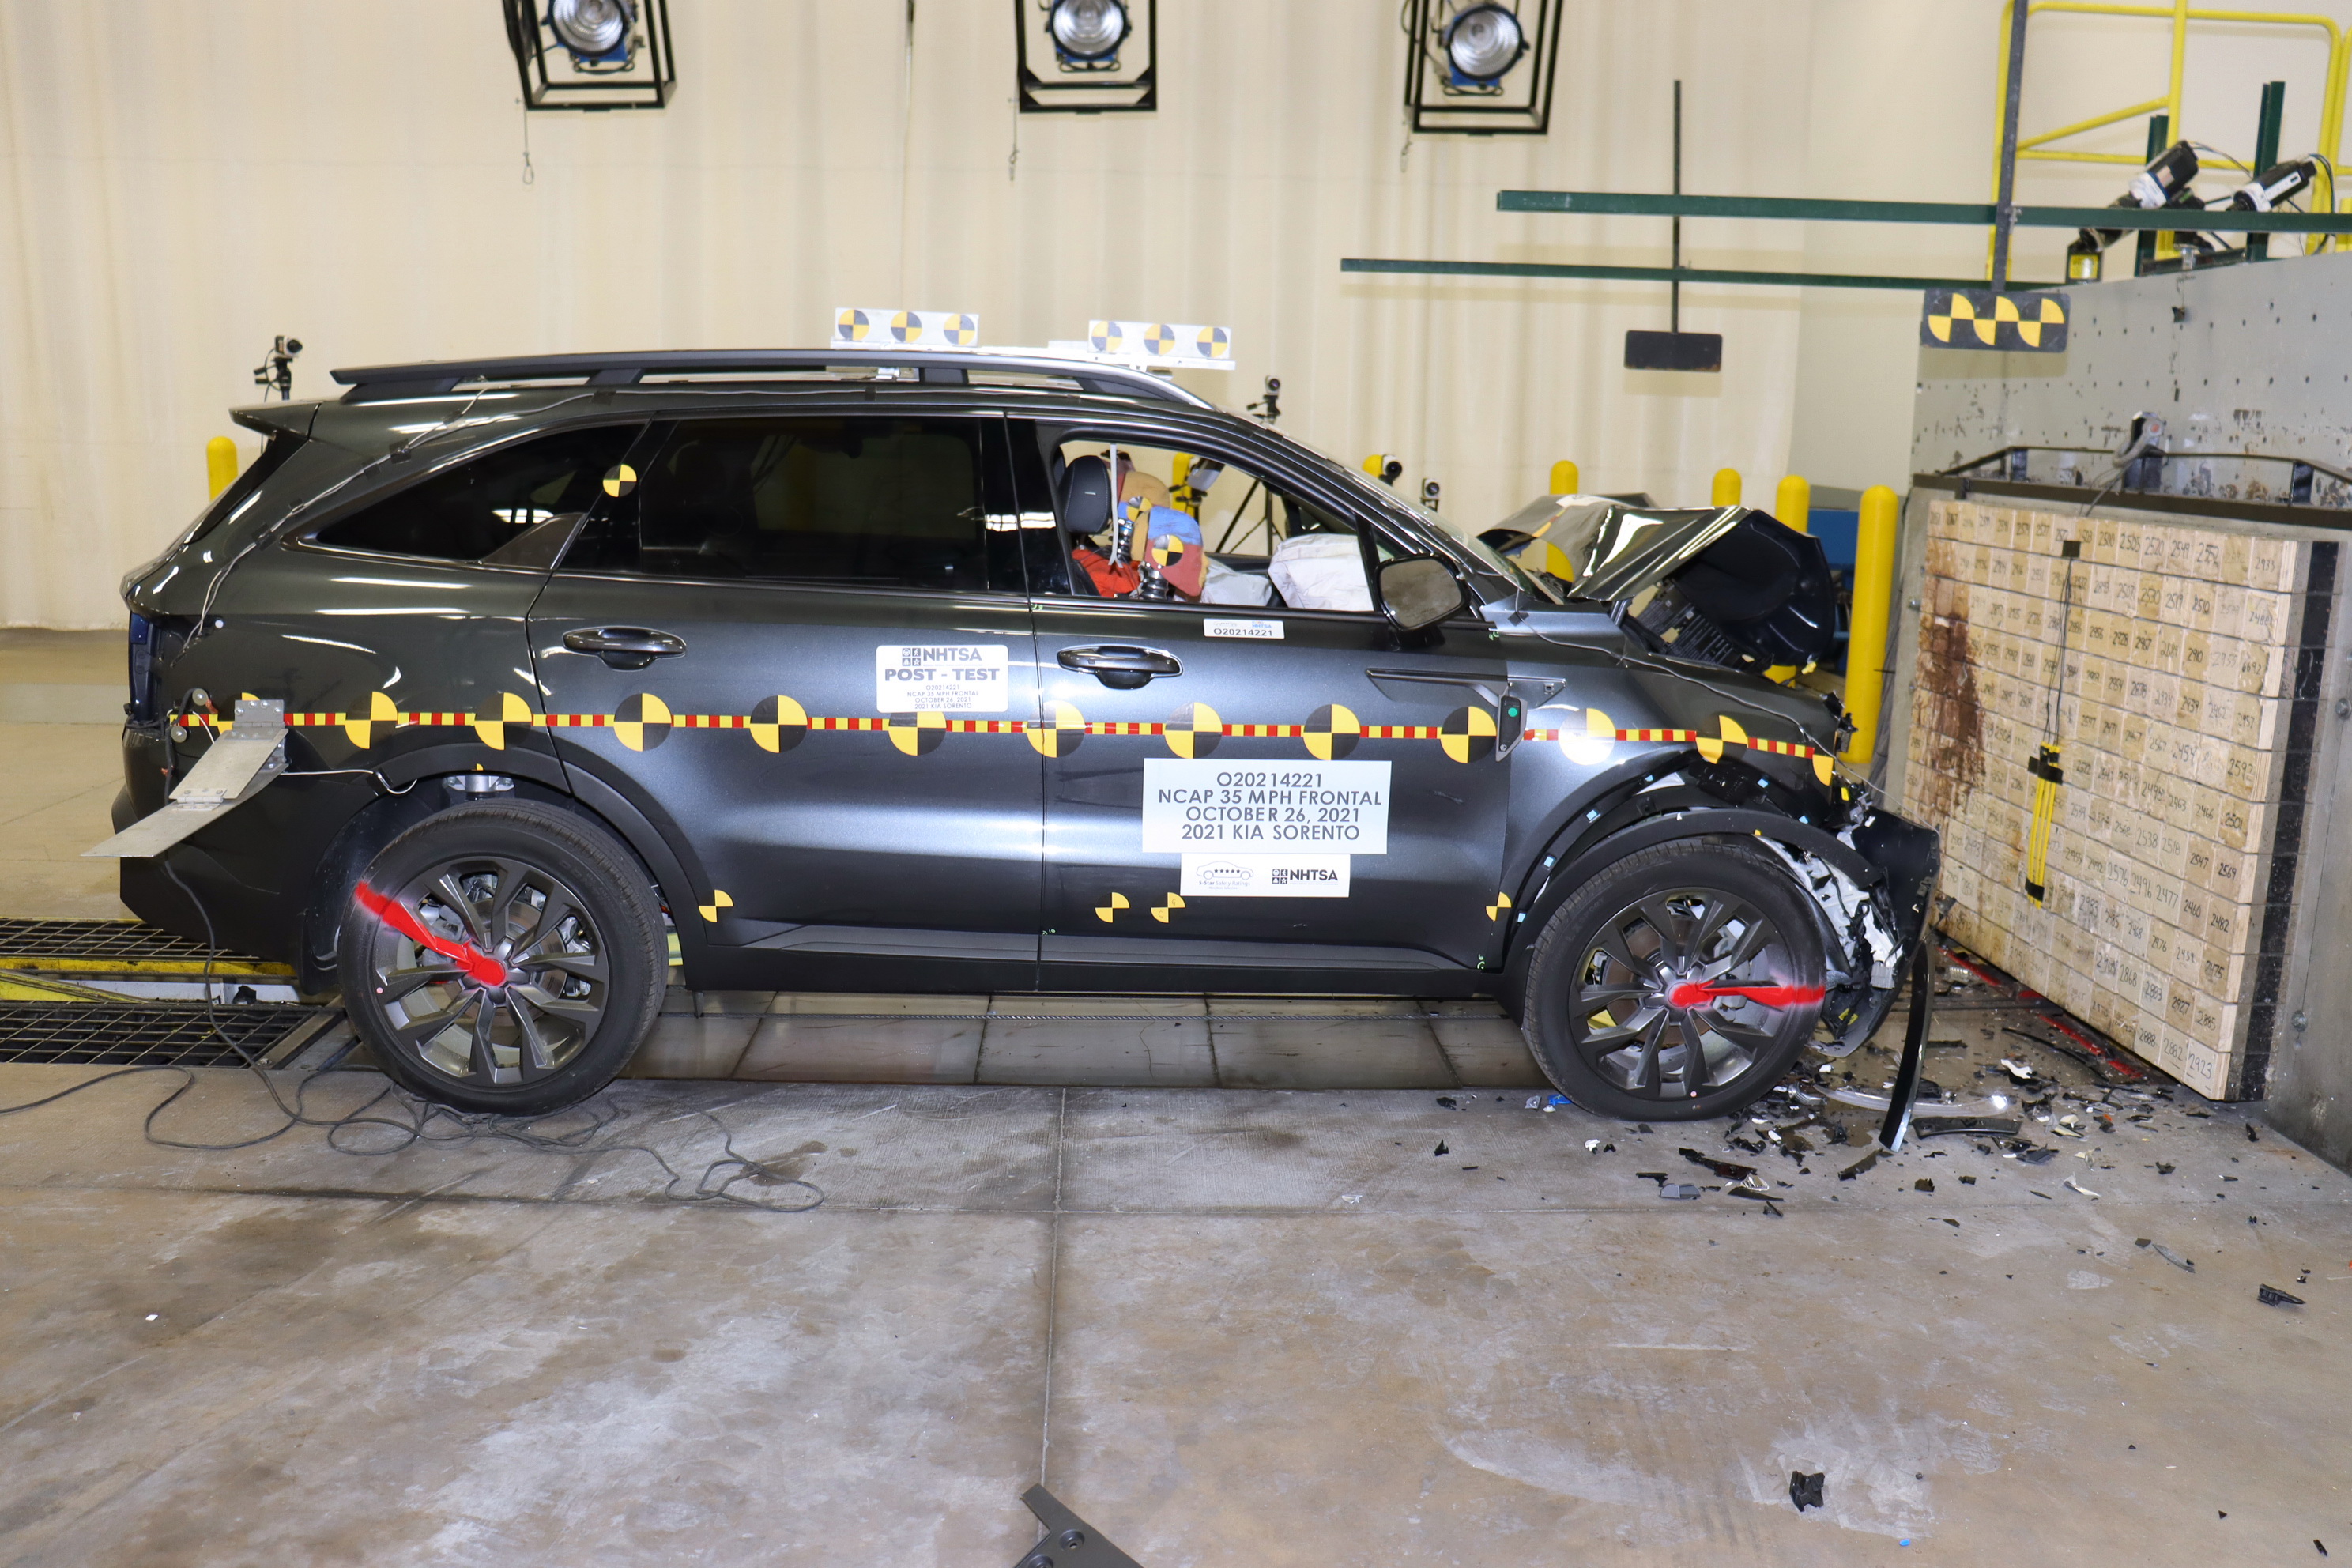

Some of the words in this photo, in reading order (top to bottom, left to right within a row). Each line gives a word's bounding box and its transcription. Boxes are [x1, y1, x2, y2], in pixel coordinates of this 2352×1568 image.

[2098, 531, 2115, 548] 2500
[2120, 533, 2141, 552] 2505
[2144, 536, 2165, 557] 2520
[2170, 539, 2190, 560] 2549
[2255, 556, 2275, 572] 2933
[2139, 586, 2161, 605] 2530
[2165, 592, 2183, 610] 2519
[2191, 594, 2211, 615] 2510
[923, 647, 982, 662] NHTSA
[2187, 647, 2203, 665] 2910
[884, 669, 937, 681] POST
[952, 668, 1000, 680] TEST
[2241, 660, 2262, 677] 6692
[2154, 688, 2174, 709] 2934
[1216, 772, 1322, 788] O20214221
[1159, 789, 1214, 804] NCAP
[1220, 790, 1242, 804] 35
[1248, 790, 1291, 805] MPH
[1299, 790, 1381, 805] FRONTAL
[2168, 794, 2187, 812] 2463
[1185, 806, 1278, 822] OCTOBER
[1284, 808, 1311, 824] 26,
[1317, 808, 1359, 822] 2021
[2195, 802, 2214, 822] 2466
[2224, 810, 2243, 832] 2501
[1182, 824, 1223, 839] 2021
[1233, 824, 1264, 839] KIA
[1273, 825, 1359, 840] SORENTO
[2135, 827, 2158, 853] 2538
[2161, 835, 2180, 858] 2518
[2190, 850, 2209, 871] 2547
[1289, 869, 1338, 881] NHTSA
[2107, 861, 2128, 888] 2576
[2218, 861, 2237, 883] 2569
[2130, 871, 2153, 902] 2496
[2154, 882, 2178, 910] 2477
[2183, 897, 2202, 920] 2460
[2210, 911, 2230, 934] 2482
[2150, 933, 2168, 955] 2476
[2118, 962, 2137, 989] 2868
[2171, 993, 2189, 1017] 2927
[2162, 1037, 2184, 1064] 2882
[2188, 1050, 2213, 1080] 2923
